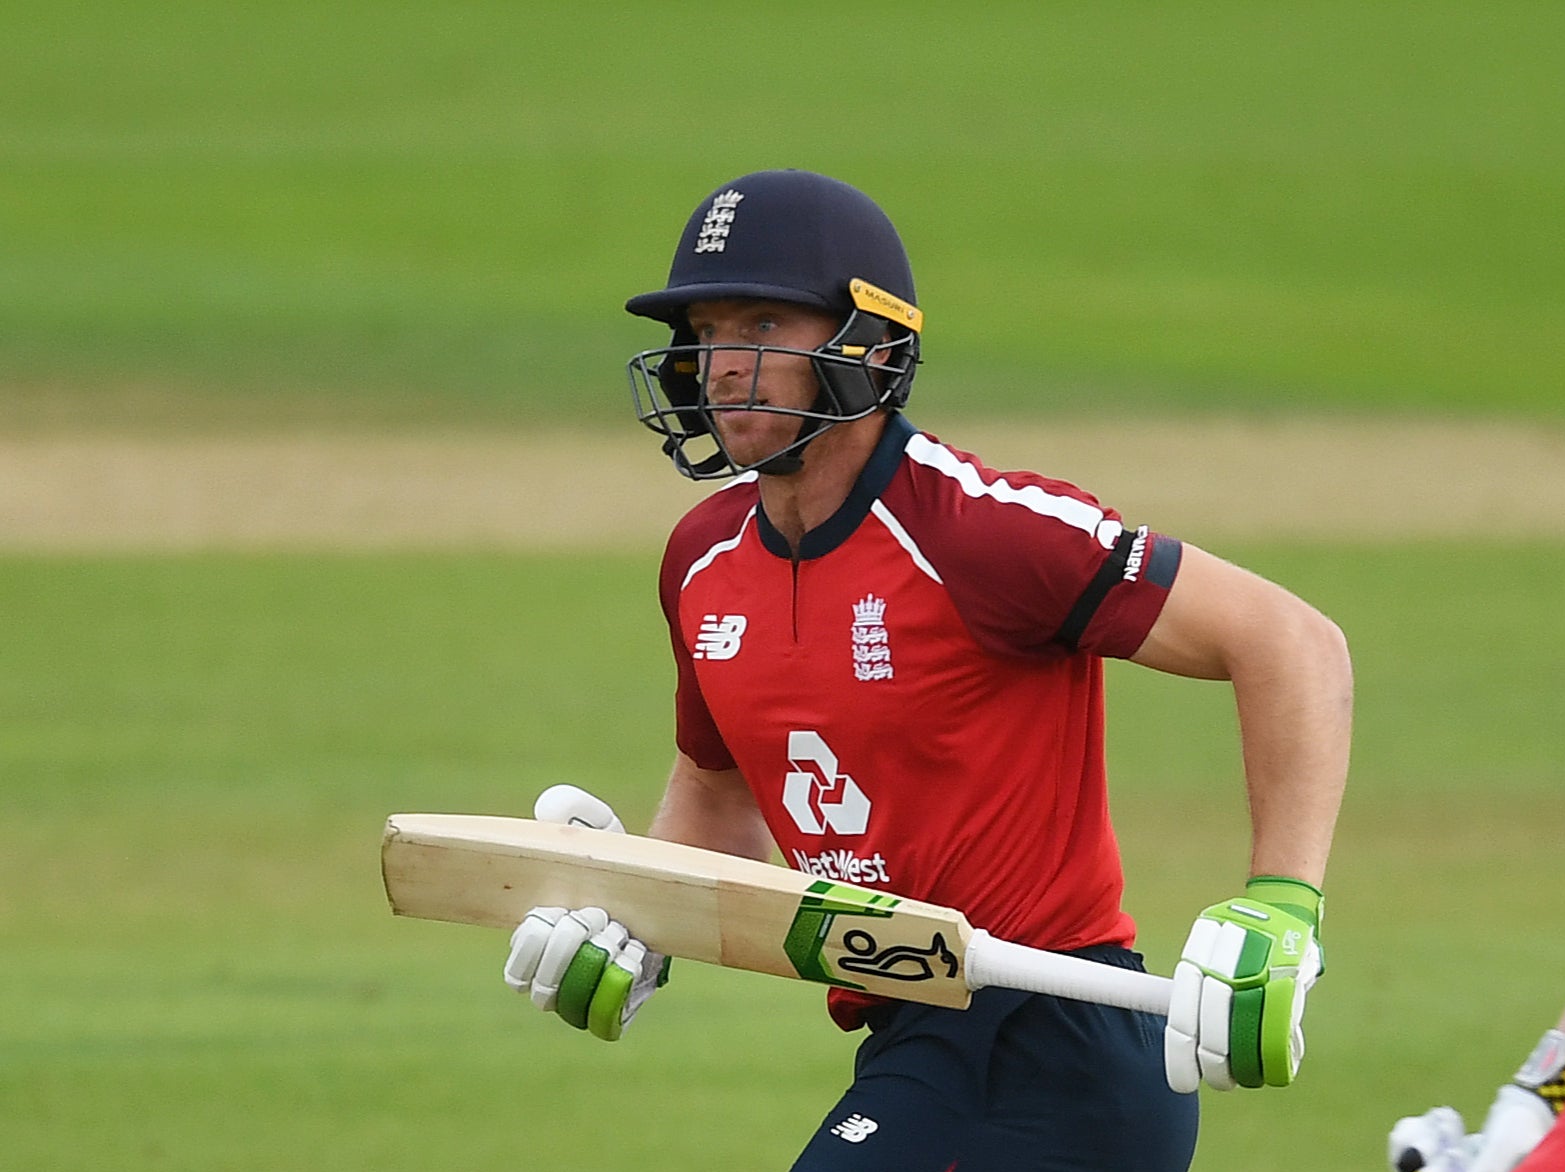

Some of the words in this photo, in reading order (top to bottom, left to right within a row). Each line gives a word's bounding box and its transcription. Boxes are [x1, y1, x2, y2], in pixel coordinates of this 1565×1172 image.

[1123, 525, 1149, 582] NatWe
[692, 614, 748, 660] NB
[791, 848, 891, 883] NatWest
